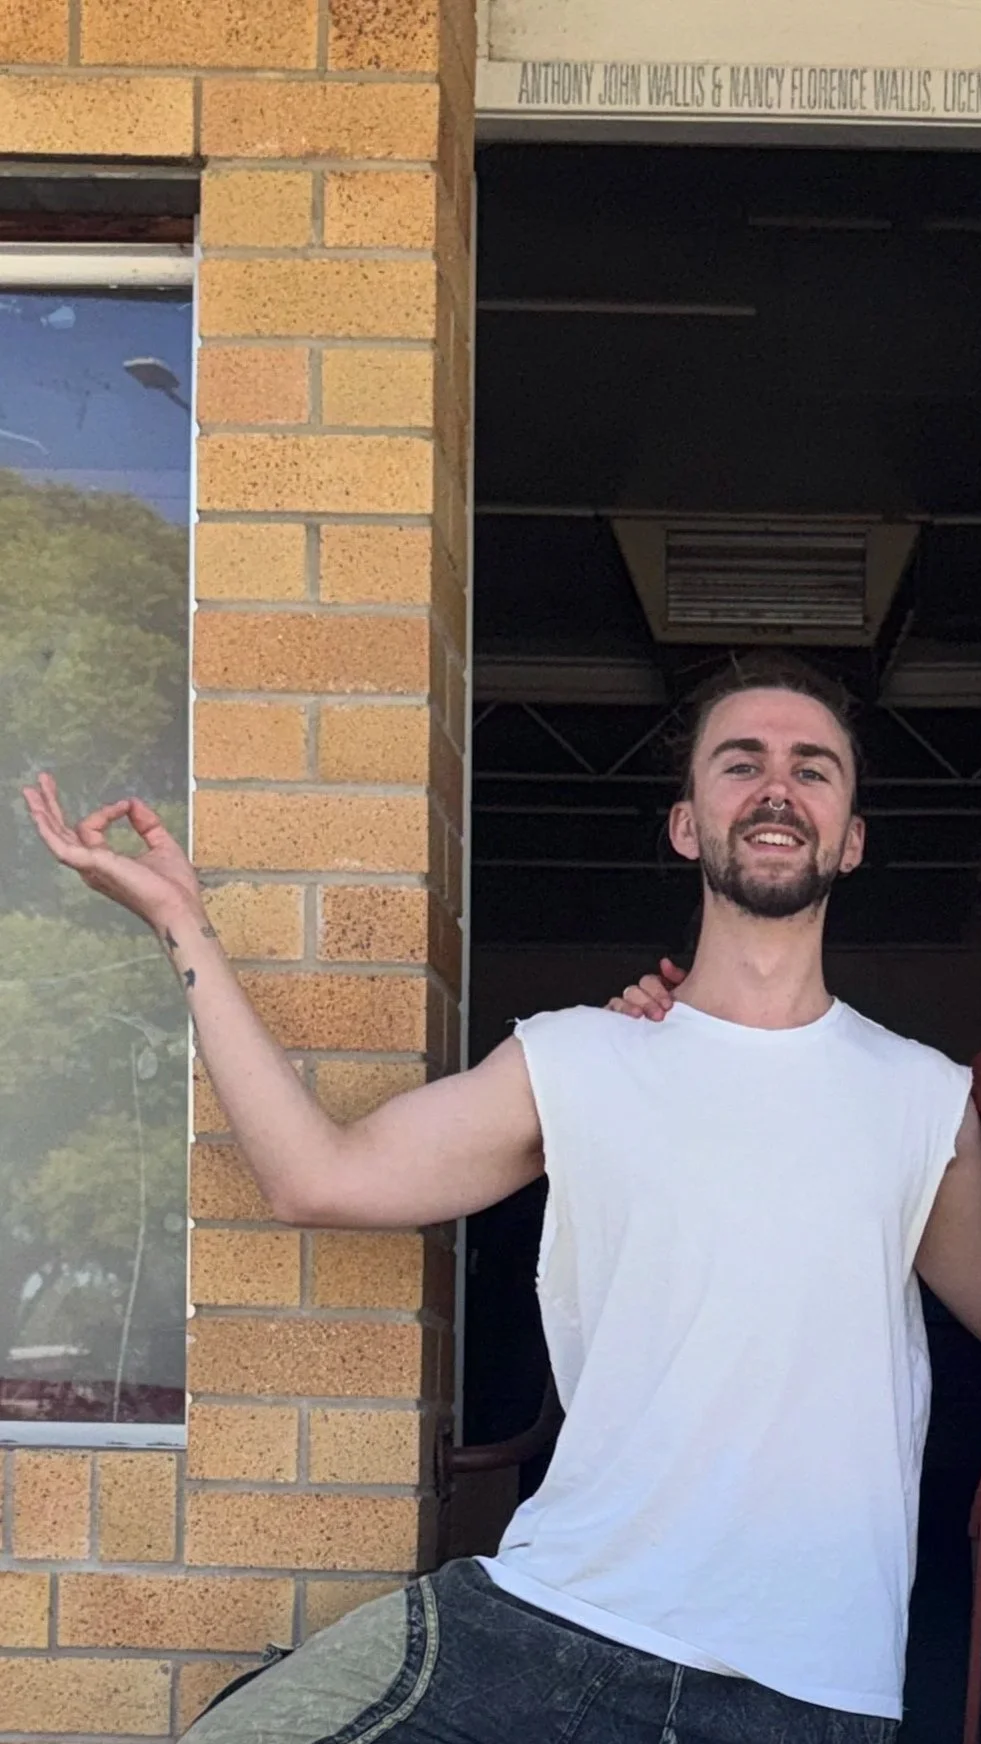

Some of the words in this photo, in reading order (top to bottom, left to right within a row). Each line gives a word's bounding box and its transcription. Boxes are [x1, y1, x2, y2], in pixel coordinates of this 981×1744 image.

[518, 62, 594, 104] ANTHONY
[598, 64, 641, 106] JOHN
[648, 65, 705, 107] WALLIS
[712, 66, 723, 108] &
[730, 66, 785, 109] NANCY
[790, 67, 868, 110] FLORENCE
[873, 69, 936, 114] WALLIS,
